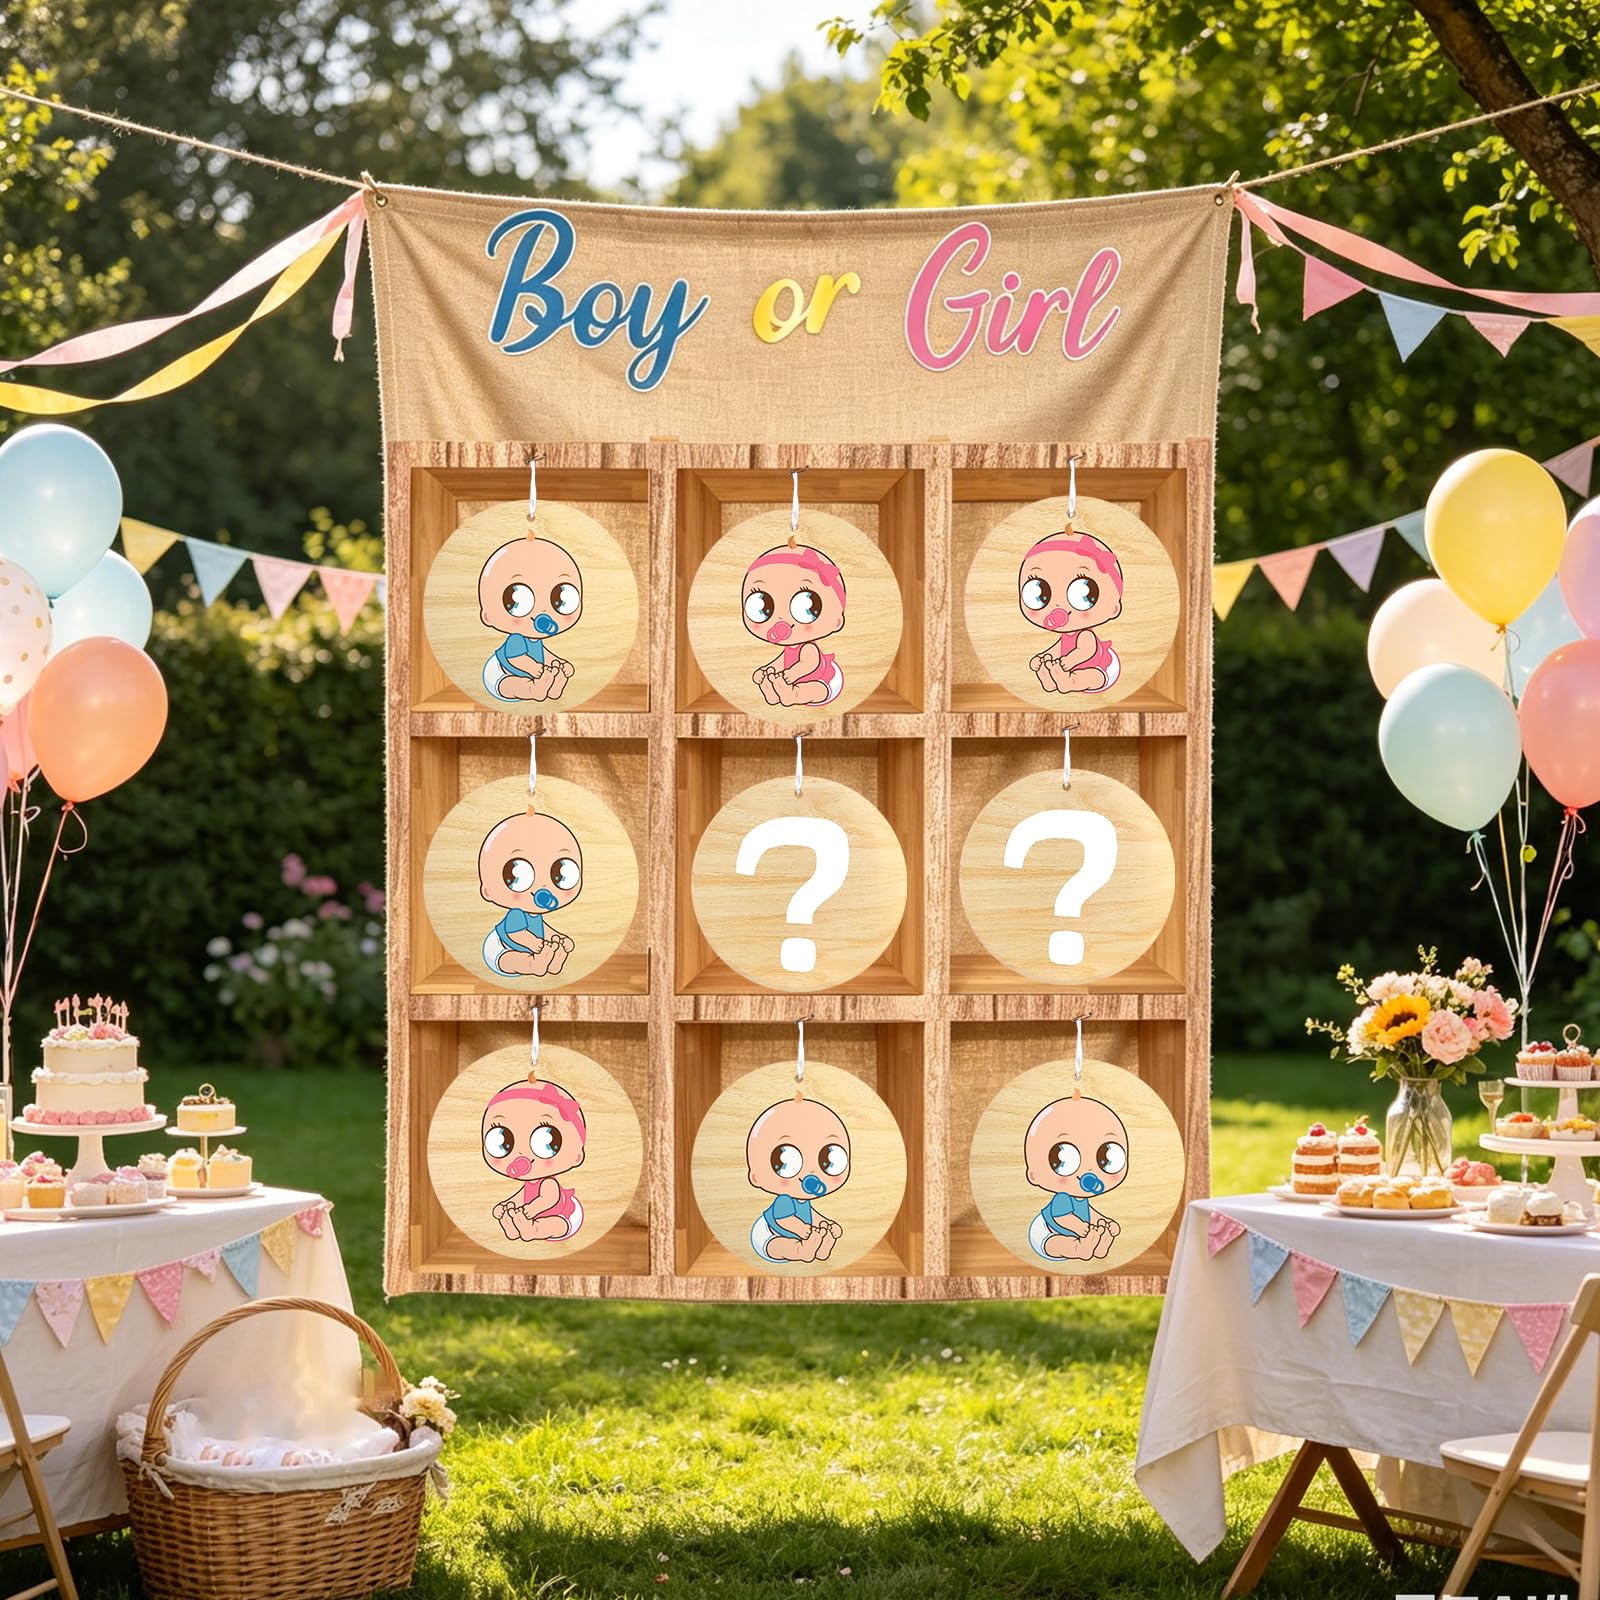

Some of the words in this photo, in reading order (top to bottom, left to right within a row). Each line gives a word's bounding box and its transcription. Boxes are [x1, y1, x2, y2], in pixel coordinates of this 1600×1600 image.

[486, 209, 710, 392] Boy
[753, 271, 861, 344] or
[905, 221, 1122, 372] Girl
[735, 816, 850, 973] ?
[1003, 809, 1118, 965] ?
